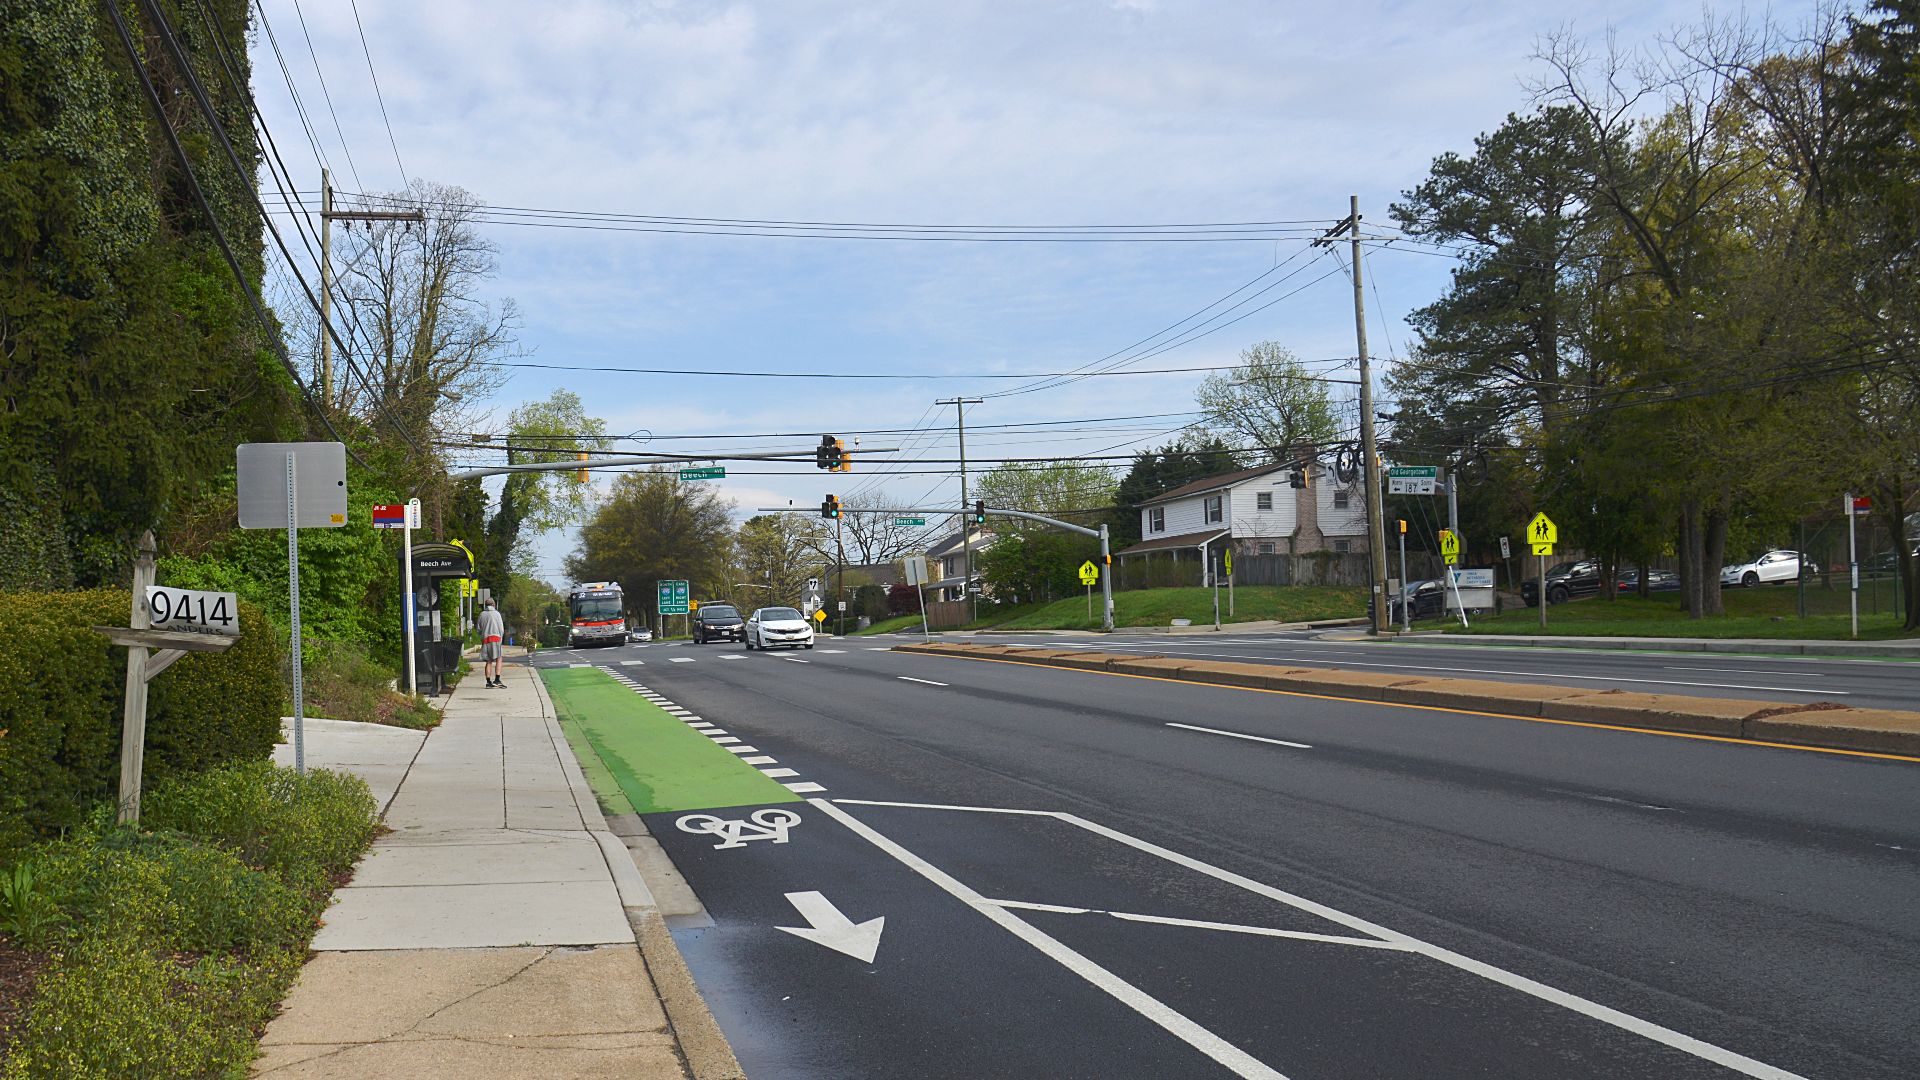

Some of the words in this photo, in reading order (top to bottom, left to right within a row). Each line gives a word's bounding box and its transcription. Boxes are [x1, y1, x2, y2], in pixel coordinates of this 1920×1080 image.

[682, 471, 707, 479] Beech
[1405, 484, 1418, 493] 187
[151, 591, 233, 626] 9414
